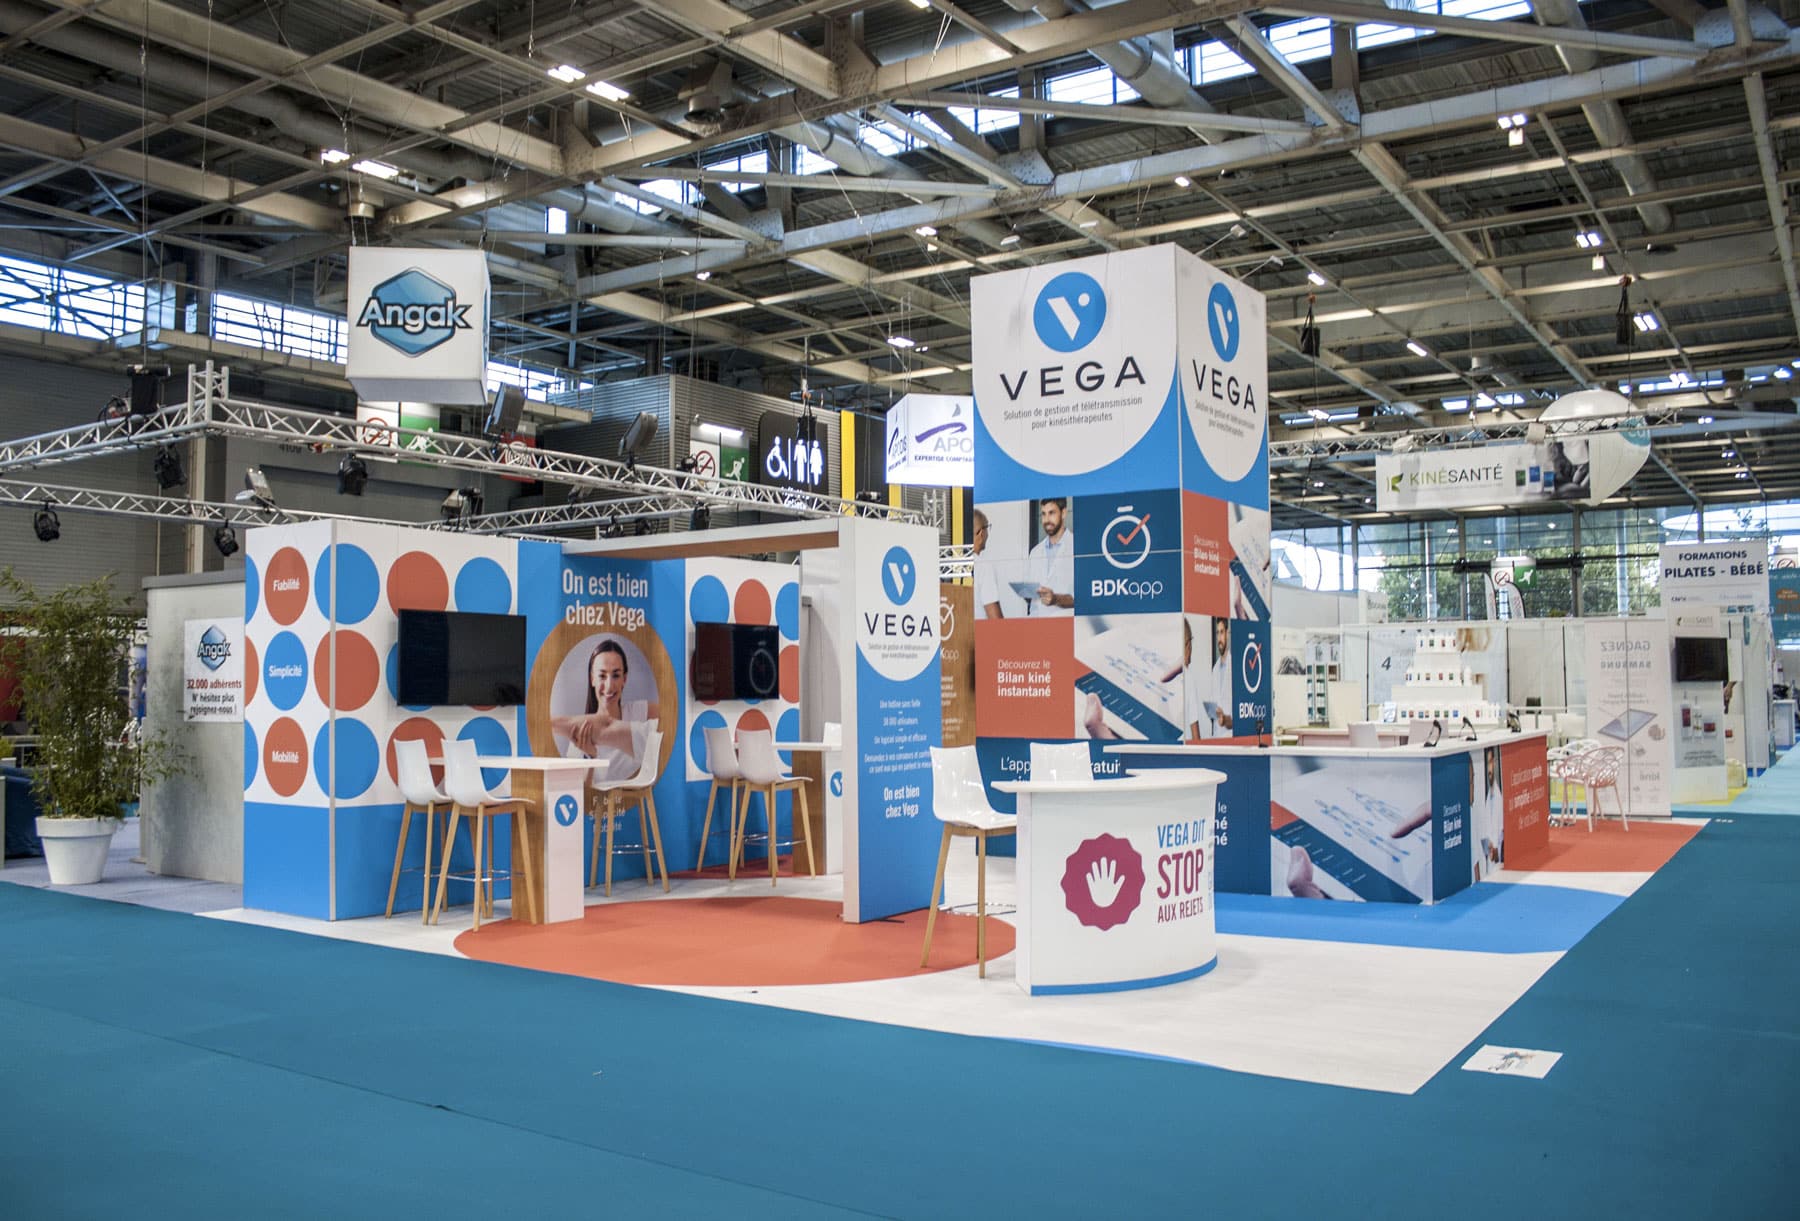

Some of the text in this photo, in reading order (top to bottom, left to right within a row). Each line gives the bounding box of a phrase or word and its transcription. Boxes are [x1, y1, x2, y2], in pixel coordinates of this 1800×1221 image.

[356, 297, 473, 335] Angak
[999, 355, 1146, 401] VEGA
[1192, 359, 1257, 414] VEGA
[1003, 396, 1143, 421] Solution de gestion et télétransmission
[1031, 412, 1113, 431] pour kinésithérapeutes
[1409, 463, 1503, 486] KINÉSANTÉ
[1679, 550, 1748, 561] FORMATIONS
[1664, 566, 1716, 578] PILATES
[1730, 561, 1764, 576] BÉBÉ
[273, 577, 301, 592] Fiabilité
[562, 568, 649, 598] On est bien
[1091, 578, 1163, 600] BDKapp
[565, 599, 646, 632] chez Vega
[864, 612, 933, 638] VEGA
[197, 642, 231, 661] Angak
[268, 664, 303, 679] Simplicité
[997, 659, 1051, 670] Découvrez le
[1381, 656, 1391, 671] 4
[187, 679, 242, 689] 32.000 adhérents
[997, 671, 1051, 684] Bilan kiné
[200, 692, 221, 702] hésitez
[221, 692, 235, 703] plus
[997, 685, 1051, 697] instantané
[190, 705, 233, 716] rejoignez-nous
[1239, 701, 1267, 721] BDKapp
[271, 750, 300, 764] Mobilité
[883, 783, 920, 801] On est bien
[885, 801, 919, 818] chez Vega
[1157, 818, 1206, 849] VEGA DIT
[1157, 848, 1204, 899] STOP
[1157, 896, 1204, 923] AUX REJETS
